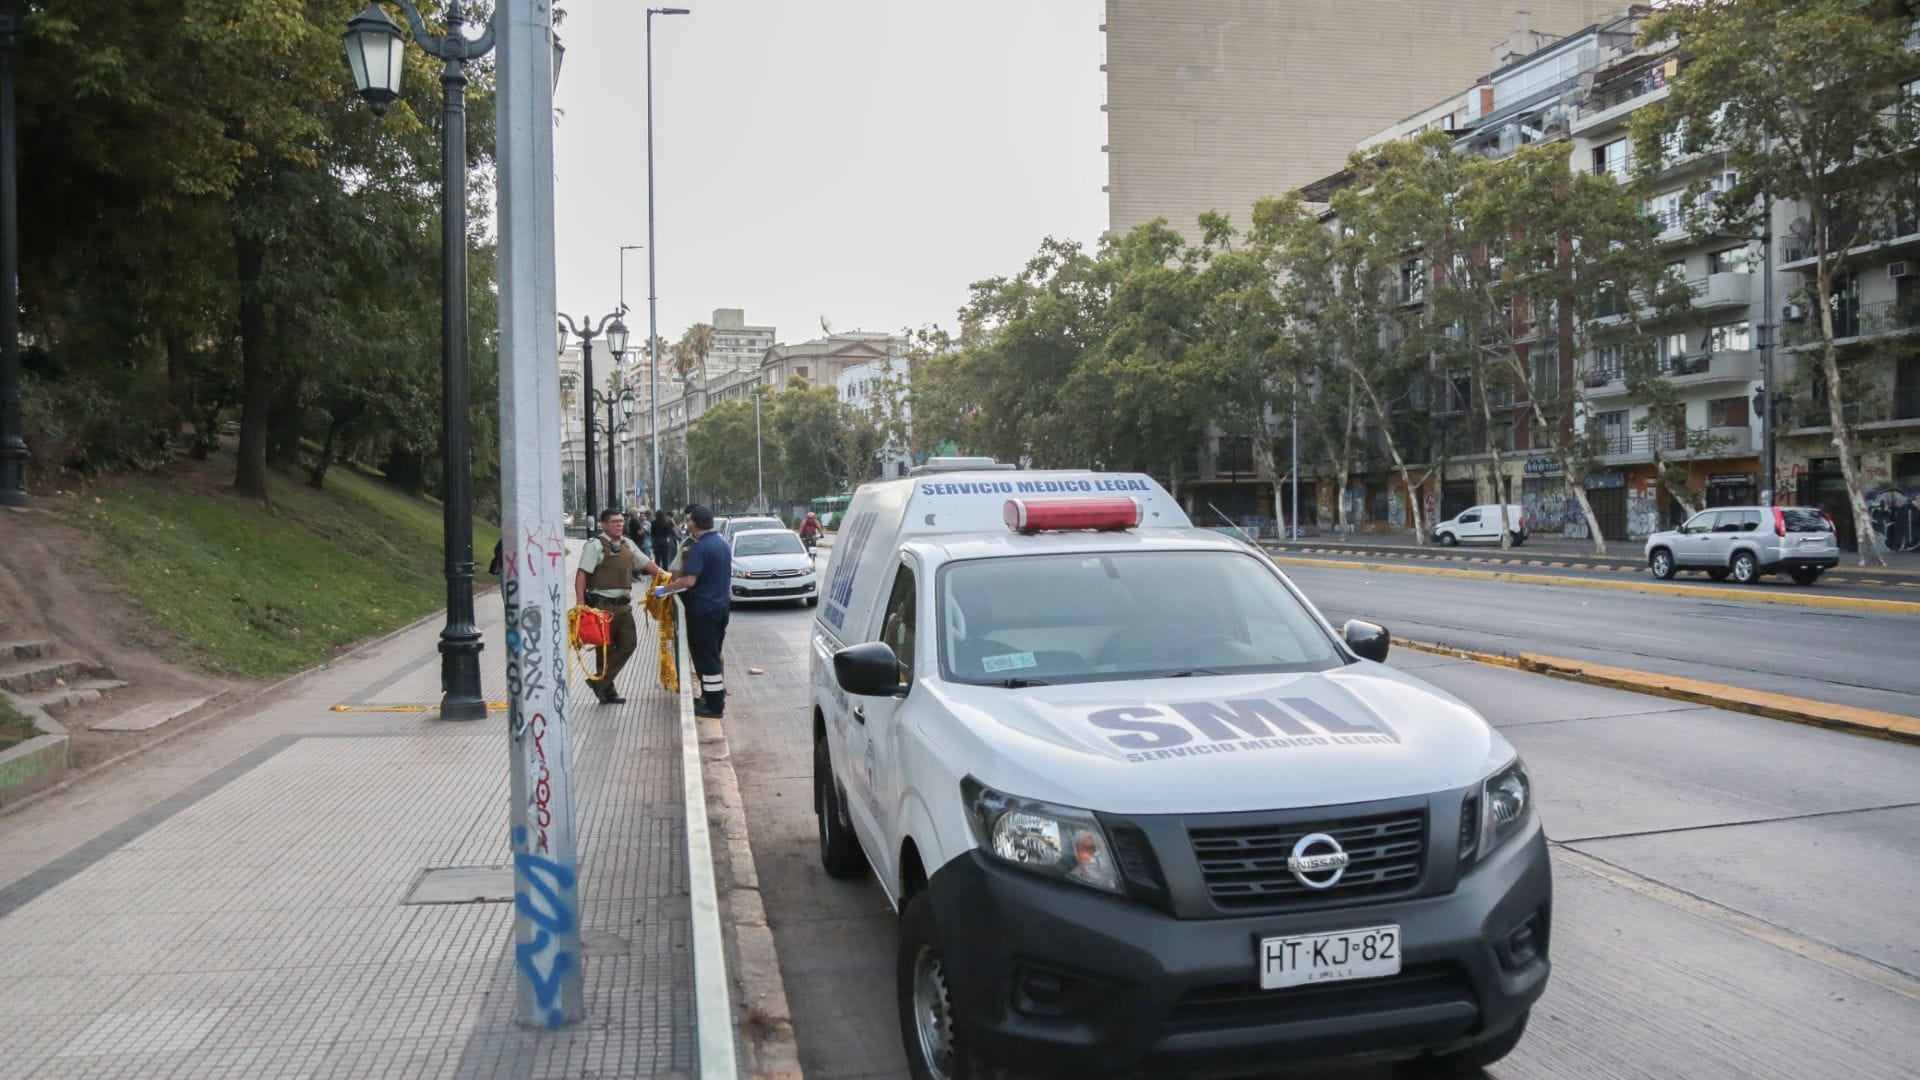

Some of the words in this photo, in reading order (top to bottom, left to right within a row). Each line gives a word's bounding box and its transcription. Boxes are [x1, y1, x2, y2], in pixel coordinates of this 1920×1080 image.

[921, 482, 1013, 495] SERVICIO
[1018, 480, 1092, 493] MÉDICO
[1094, 479, 1150, 491] LEGAL
[1087, 697, 1382, 750] SML
[1126, 743, 1237, 763] SERVICIO
[1297, 857, 1345, 869] NISSAN
